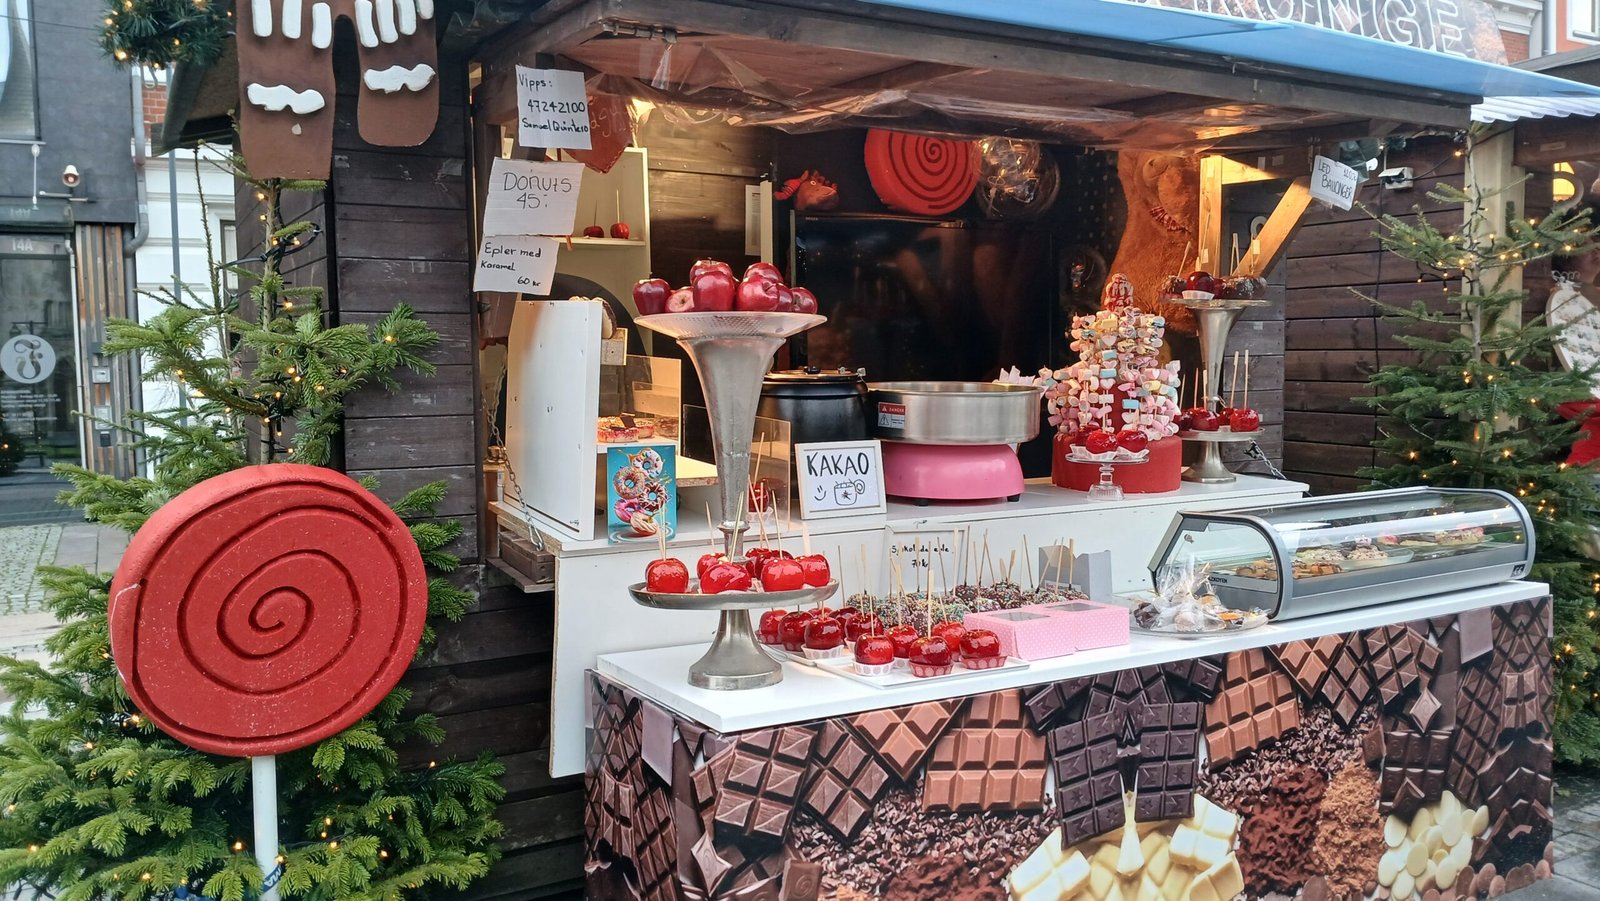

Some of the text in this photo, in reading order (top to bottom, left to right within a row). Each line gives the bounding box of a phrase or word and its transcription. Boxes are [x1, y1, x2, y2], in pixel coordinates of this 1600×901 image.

[518, 73, 553, 91] Vipps:
[527, 99, 586, 114] 47242100
[1318, 159, 1331, 174] LED
[12, 238, 33, 251] 14A
[484, 242, 542, 258] Epler med
[517, 276, 531, 285] 60
[806, 452, 869, 477] KAKAO
